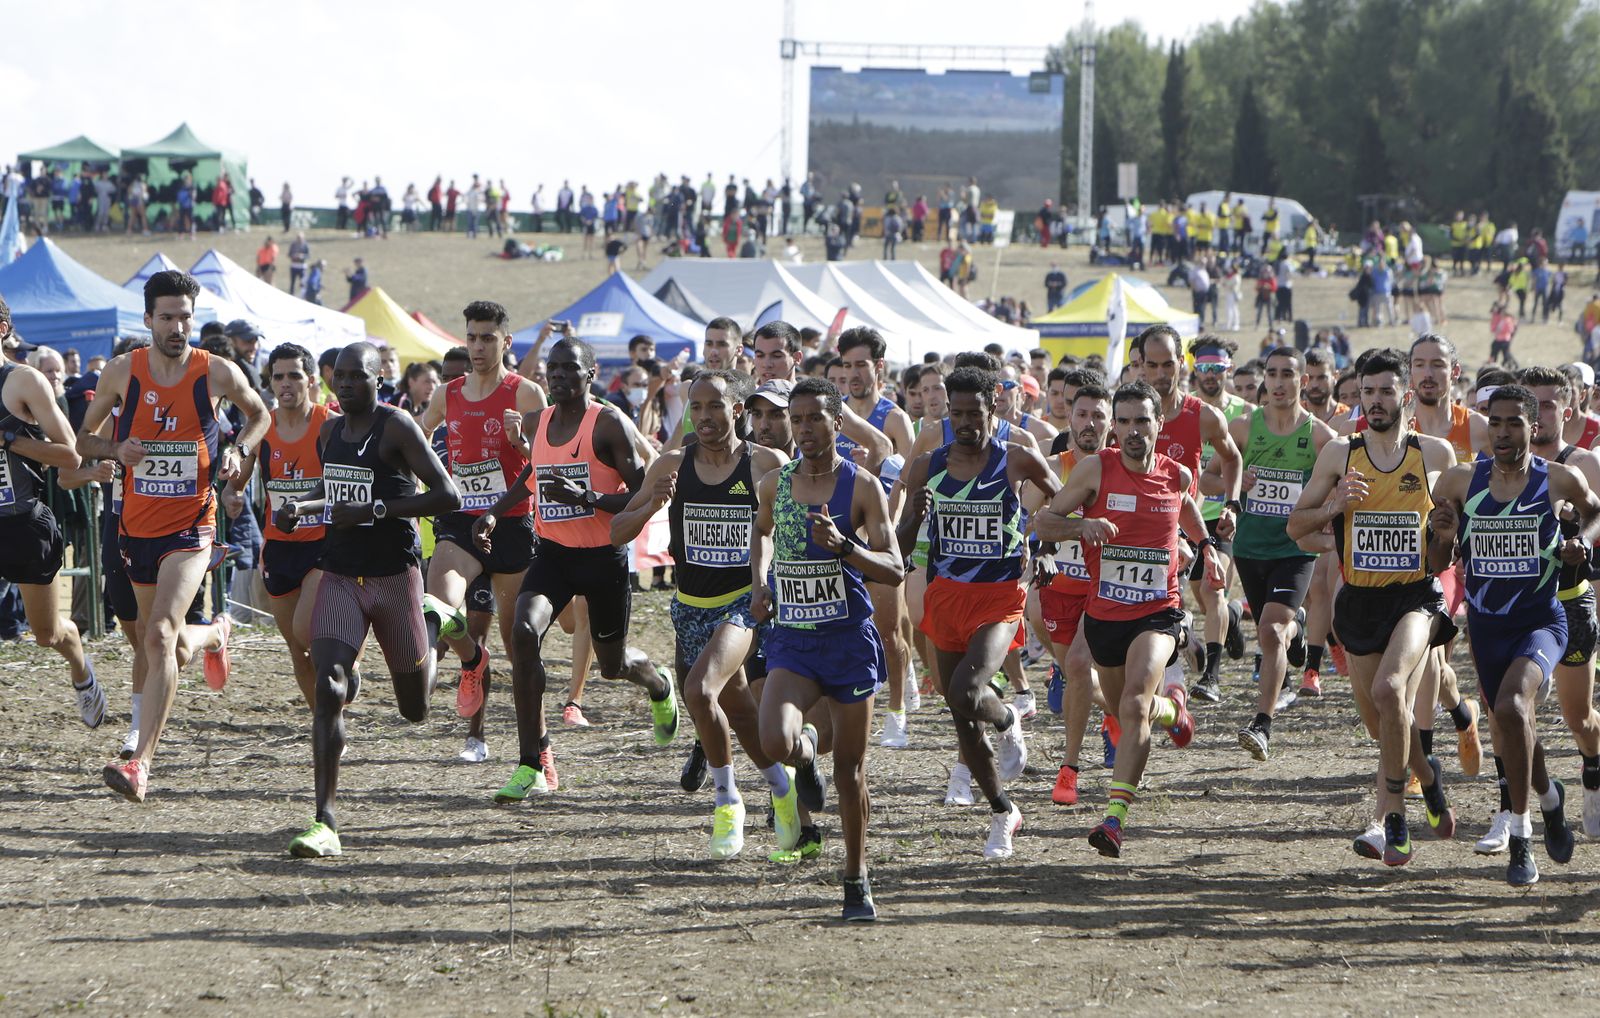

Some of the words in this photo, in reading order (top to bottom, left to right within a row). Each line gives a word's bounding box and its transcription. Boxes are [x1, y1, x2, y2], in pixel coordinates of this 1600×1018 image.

[167, 445, 174, 453] DE
[175, 445, 196, 454] SEVILLA
[145, 460, 183, 478] 234
[472, 465, 480, 474] DE
[480, 460, 500, 472] SEVILLA
[568, 466, 588, 476] SEVILLA
[346, 470, 353, 478] DE
[354, 470, 374, 480] SEVILLA
[1276, 471, 1284, 480] DE
[1284, 472, 1302, 480] SEVILLA
[140, 480, 187, 494] Joma
[267, 481, 294, 490] DIPUTACION
[295, 481, 302, 489] DE
[460, 476, 492, 492] 162
[328, 482, 368, 504] AYEKO
[1257, 483, 1290, 500] 330
[542, 504, 586, 520] Joma
[685, 508, 720, 518] DIPUTACION
[720, 510, 728, 518] DE
[730, 509, 752, 518] SEVILLA
[939, 503, 971, 512] DIPUTACION
[972, 504, 980, 513] DE
[980, 504, 1001, 514] SEVILLA
[1250, 501, 1290, 514] Joma
[1354, 514, 1389, 524] DIPUTACION
[1390, 516, 1398, 524] DE
[1398, 516, 1420, 524] SEVILLA
[1471, 520, 1504, 529] DIPUTACION
[1506, 520, 1514, 529] DE
[1514, 520, 1538, 528] SEVILLA
[688, 522, 748, 547] HAILESELASSIE
[942, 516, 998, 540] KIFLE
[1357, 529, 1416, 552] CATROFE
[1474, 534, 1535, 558] OUKHELFEN
[946, 542, 994, 554] Joma
[1103, 547, 1138, 559] DIPUTACION
[1139, 550, 1148, 559] DE
[692, 550, 742, 562] Joma
[1360, 555, 1411, 567] Joma
[776, 564, 806, 574] DIPUTACION
[807, 566, 816, 574] DE
[816, 564, 842, 574] SEVILLA
[1478, 560, 1530, 574] Joma
[1116, 564, 1154, 586] 114
[780, 578, 840, 604] MELAK
[1106, 585, 1154, 602] Joma
[785, 604, 838, 620] Joma
